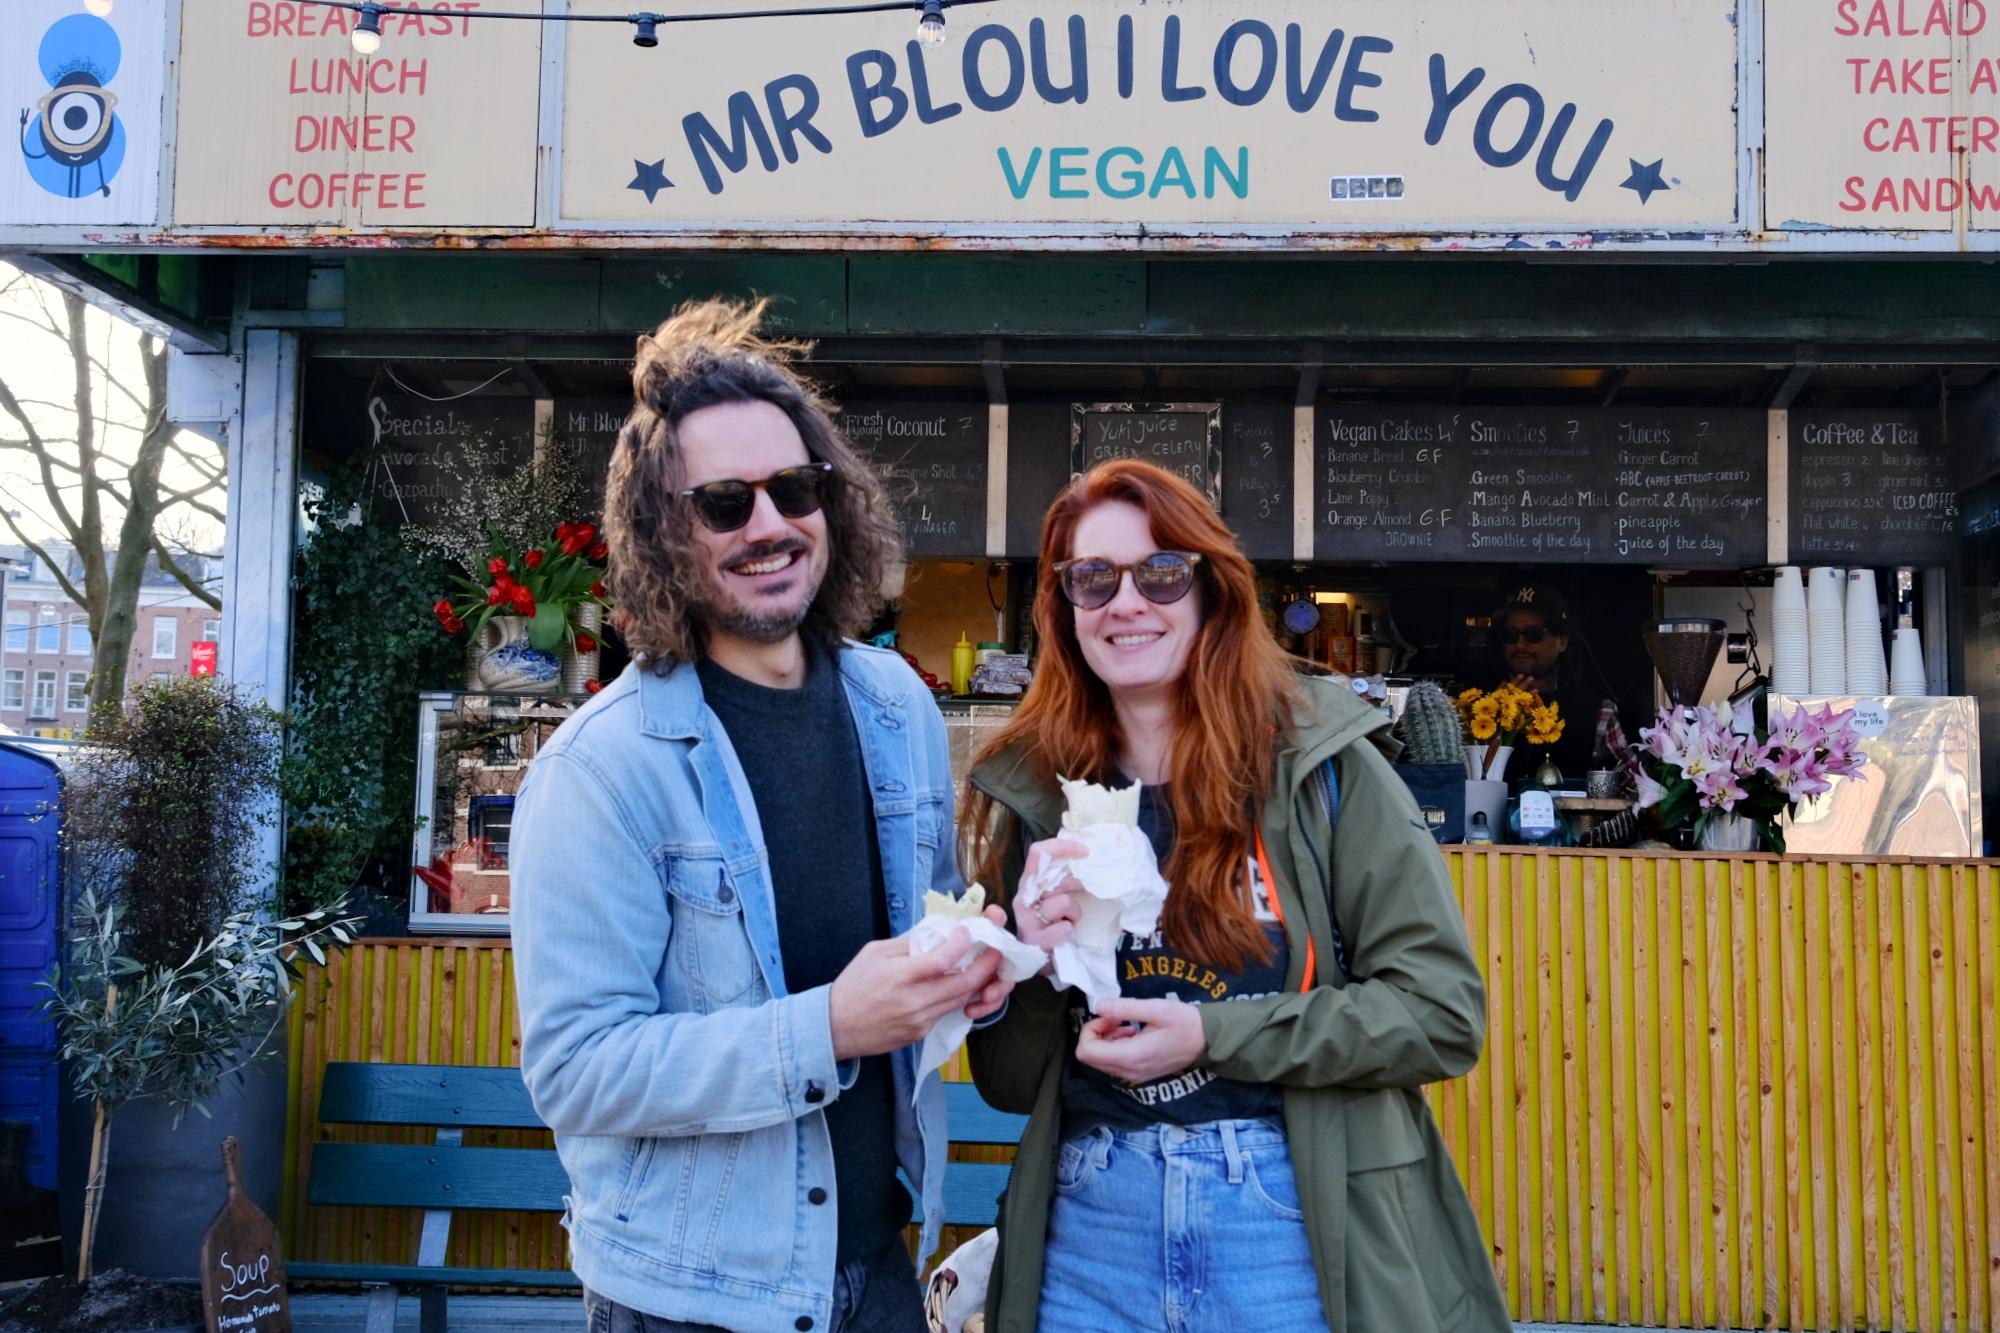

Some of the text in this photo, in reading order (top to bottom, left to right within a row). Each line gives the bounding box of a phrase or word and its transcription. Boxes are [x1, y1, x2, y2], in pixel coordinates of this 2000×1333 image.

[247, 1, 480, 37] BREAFAST
[1835, 0, 1987, 36] SALAD
[289, 58, 428, 95] LUNCH
[1846, 59, 2000, 94] TAKE A
[682, 14, 1615, 202] MR BLOU I LOVE YOU
[294, 115, 416, 153] DINER
[1863, 116, 2000, 153] CATER
[997, 146, 1249, 199] VEGAN
[268, 173, 426, 209] COFFEE
[887, 415, 946, 437] Coconut
[1099, 418, 1132, 442] Yuki
[1329, 419, 1377, 447] Vegan
[1380, 420, 1433, 442] Cakes
[1567, 420, 1580, 441] 7
[1618, 422, 1671, 444] Juices
[1803, 423, 1919, 445] Coffee & Tea
[1260, 441, 1272, 459] 3
[1328, 447, 1368, 463] Banana
[1618, 450, 1700, 470] Ginger Carrot
[1472, 468, 1574, 486] Green Smoothie
[1619, 471, 1642, 487] ABC
[1328, 488, 1389, 509] Lime Poppy
[1472, 490, 1610, 512] Mango Avocado Mint
[1618, 491, 1660, 508] Carrot
[1663, 492, 1676, 508] &
[1680, 491, 1719, 514] Apple
[1892, 495, 1915, 510] ICED
[1919, 492, 1959, 509] COFFEE
[921, 504, 932, 525] 4
[1328, 510, 1368, 530] Orange
[1373, 511, 1411, 526] Almond
[1471, 511, 1581, 533] Banana Blueberry
[1828, 514, 1858, 530] white
[1471, 531, 1591, 555] Smoothie of the day
[1658, 534, 1671, 556] of
[1676, 534, 1697, 549] the
[1701, 534, 1724, 556] day
[1854, 717, 1884, 727] my life
[1125, 956, 1228, 999] ANGELES
